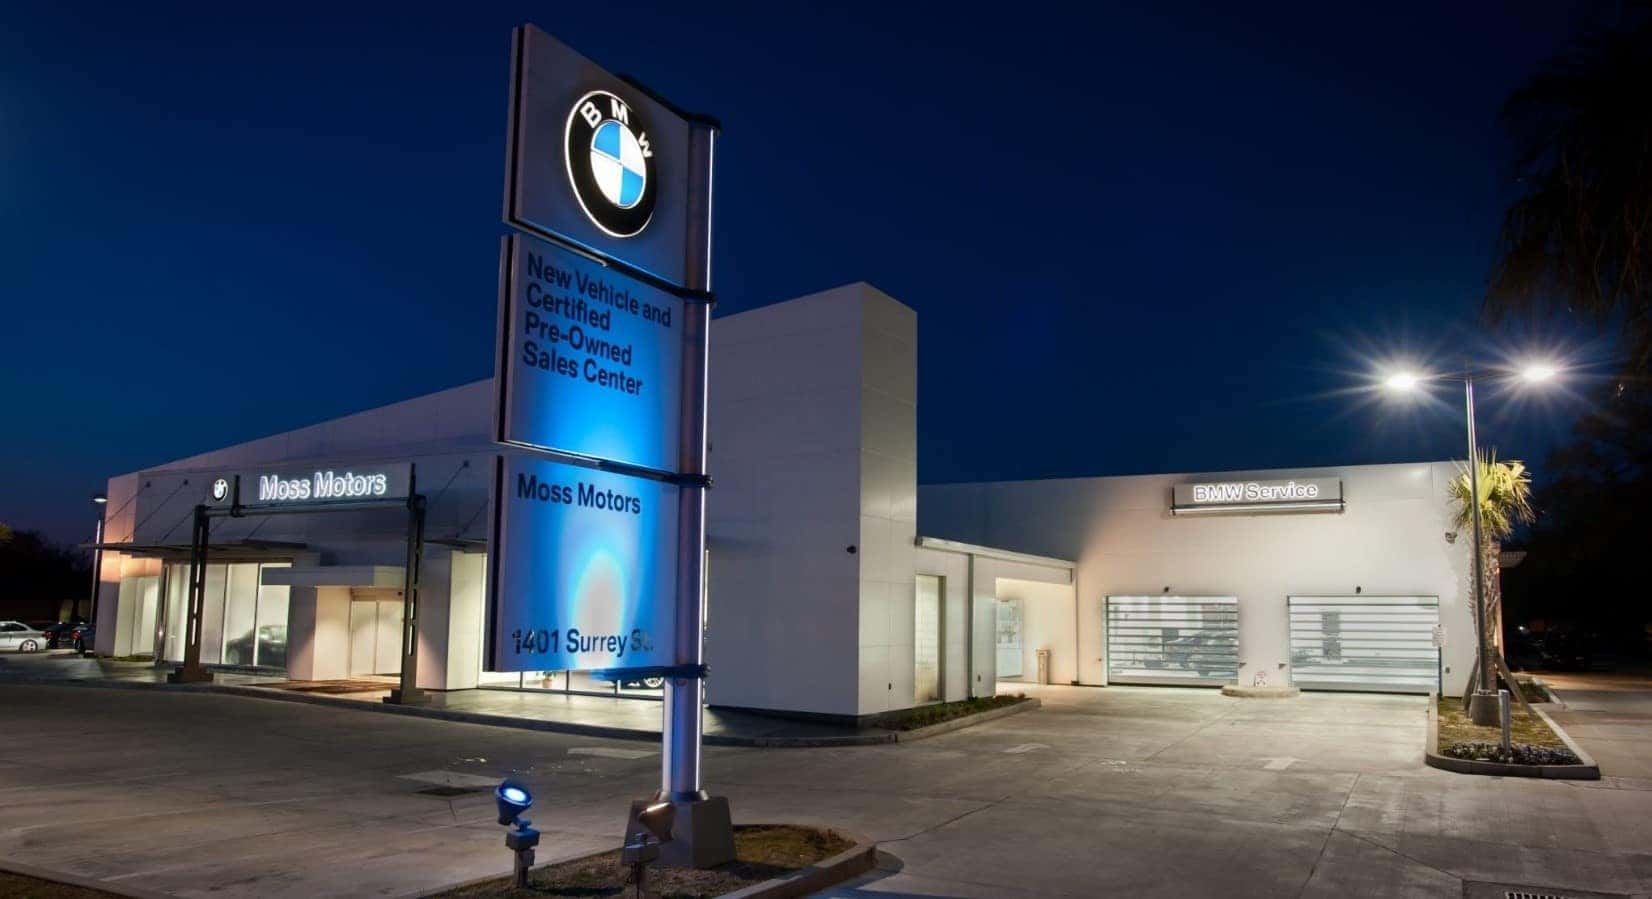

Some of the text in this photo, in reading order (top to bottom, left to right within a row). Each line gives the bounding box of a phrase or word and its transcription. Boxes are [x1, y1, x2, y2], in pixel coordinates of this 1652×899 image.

[580, 98, 653, 158] BMW
[527, 282, 611, 332] Certified
[528, 252, 672, 328] New Vehicle and
[525, 311, 632, 366] Pre-Owned
[522, 340, 643, 395] Sales Center
[259, 471, 387, 500] Moss Motors
[517, 473, 641, 514] Moss Motors
[1193, 481, 1318, 502] BMW Service
[512, 628, 559, 655] 1401
[566, 628, 628, 658] Surrey
